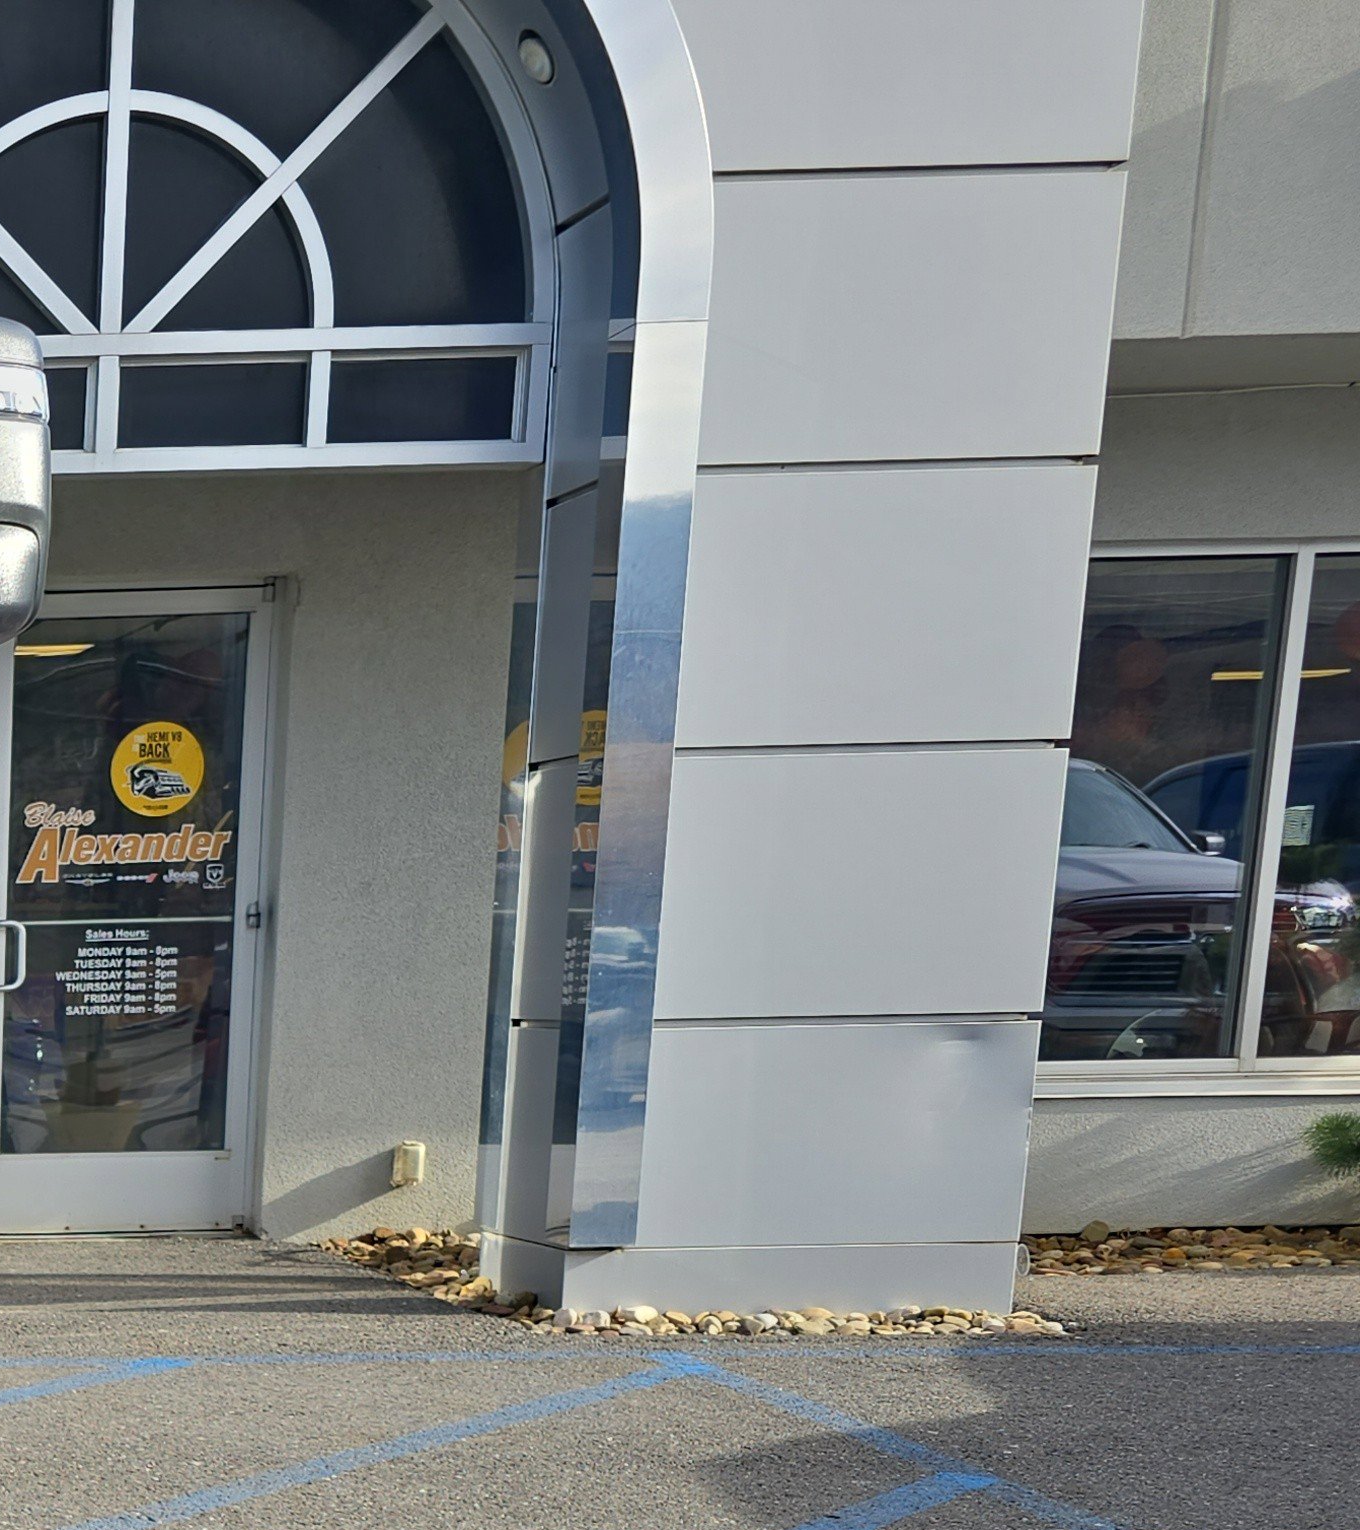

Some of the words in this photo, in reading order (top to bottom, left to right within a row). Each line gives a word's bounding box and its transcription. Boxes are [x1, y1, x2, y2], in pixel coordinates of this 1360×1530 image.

[146, 731, 169, 742] HEMI
[171, 731, 183, 742] V8
[138, 743, 171, 758] BACK
[24, 801, 96, 828] Blaise
[15, 823, 233, 884] Alexander
[85, 928, 113, 940] Sales
[115, 928, 150, 940] Hours:
[77, 946, 124, 957] MONDAY
[125, 946, 147, 956] 9am
[73, 958, 123, 969] TUESDAY
[125, 957, 147, 968] 9am
[55, 970, 123, 981] WEDNESDAY
[124, 969, 147, 980] 9am
[65, 981, 123, 993] THURSDAY
[124, 980, 146, 991] 9am
[83, 993, 123, 1004] FRIDAY
[123, 992, 146, 1003] 9am
[65, 1004, 123, 1016] SATURDAY
[123, 1004, 146, 1014] 9am
